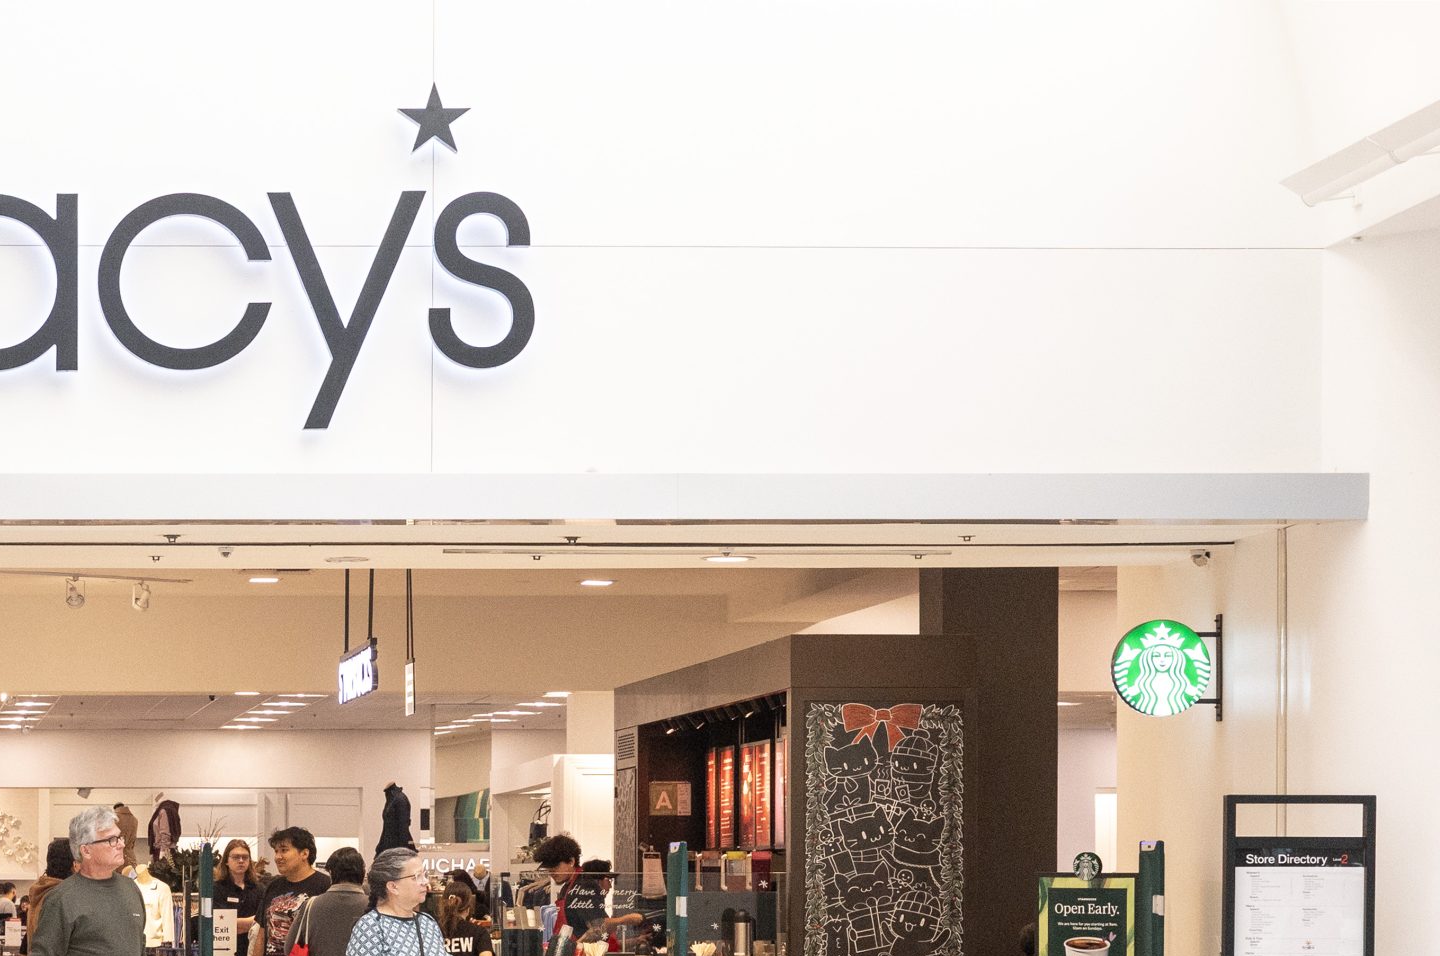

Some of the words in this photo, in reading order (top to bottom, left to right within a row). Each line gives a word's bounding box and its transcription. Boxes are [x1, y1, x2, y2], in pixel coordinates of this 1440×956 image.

[655, 791, 672, 810] A
[1245, 853, 1275, 864] Store
[1277, 853, 1328, 866] Directory
[1341, 854, 1348, 864] 2
[567, 884, 596, 896] Have
[600, 888, 607, 896] a
[613, 889, 643, 902] merry
[567, 897, 595, 909] little
[1054, 902, 1085, 917] Open
[1087, 902, 1120, 917] Early.
